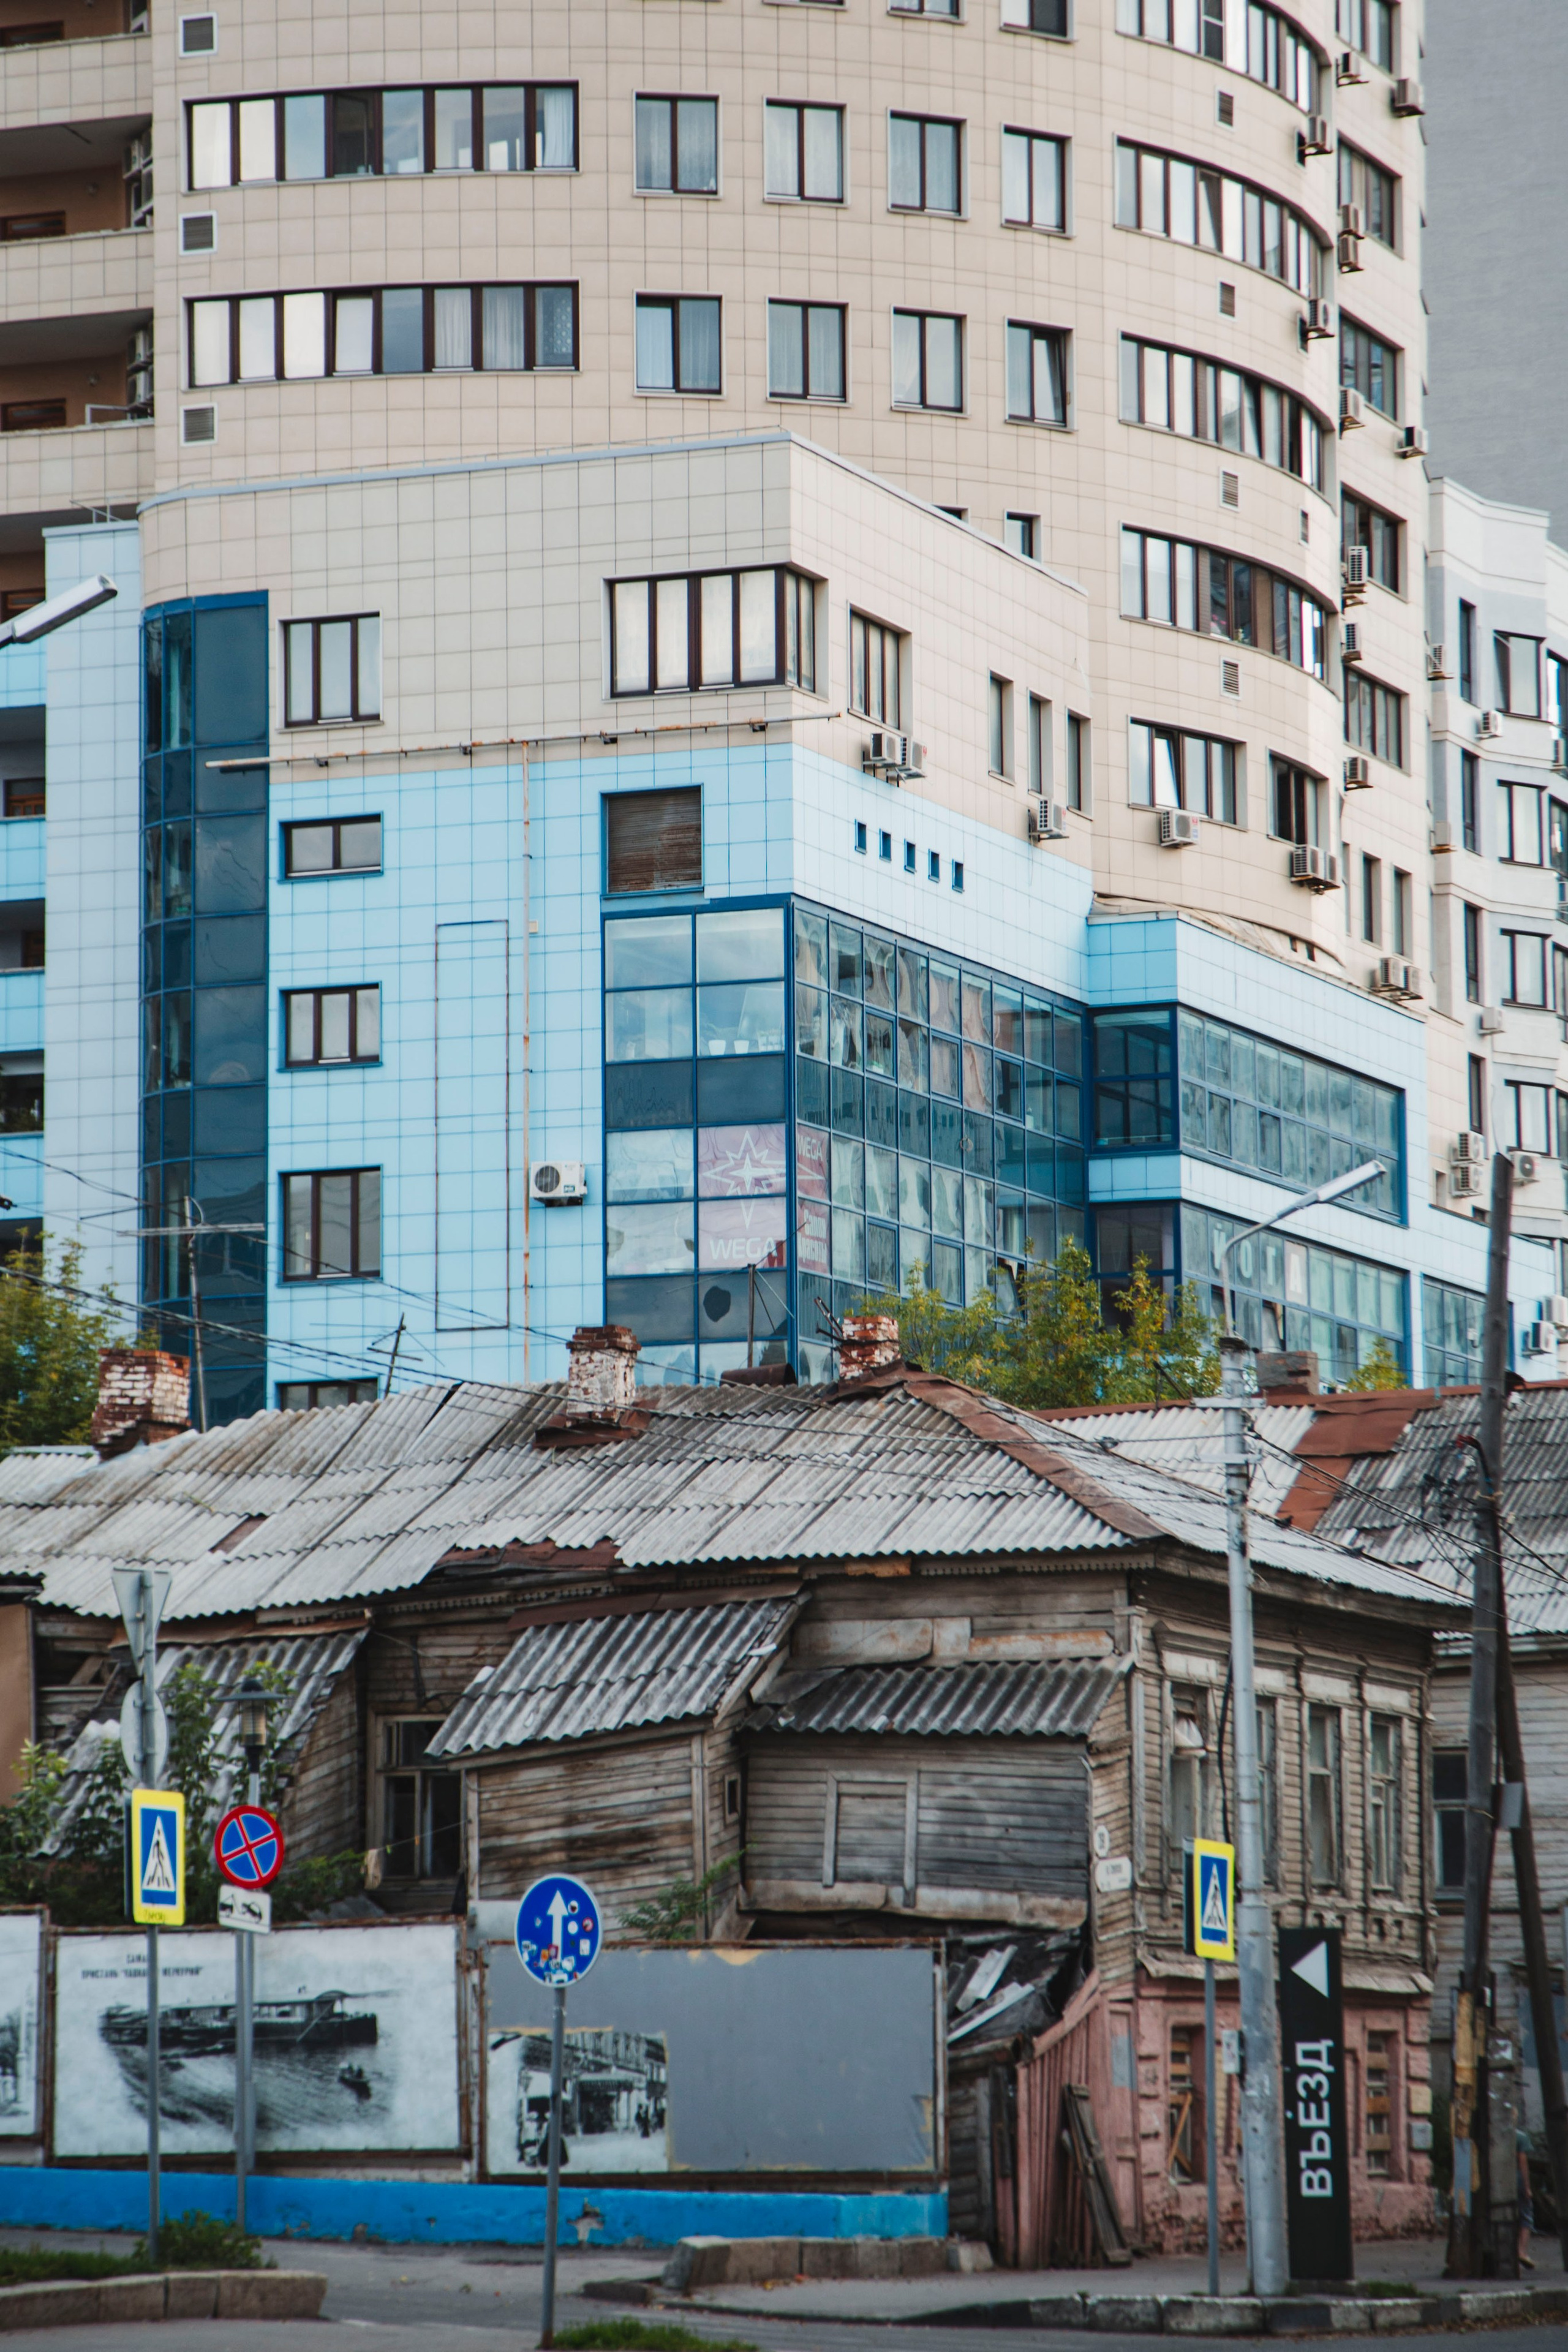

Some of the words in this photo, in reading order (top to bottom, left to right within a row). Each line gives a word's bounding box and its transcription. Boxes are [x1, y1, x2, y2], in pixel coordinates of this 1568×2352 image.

[797, 1134, 823, 1161] WEGA
[710, 1237, 778, 1260] WEGA
[1213, 1223, 1302, 1294] ЙОГА
[1295, 2038, 1335, 2198] ВЪЕЗД
